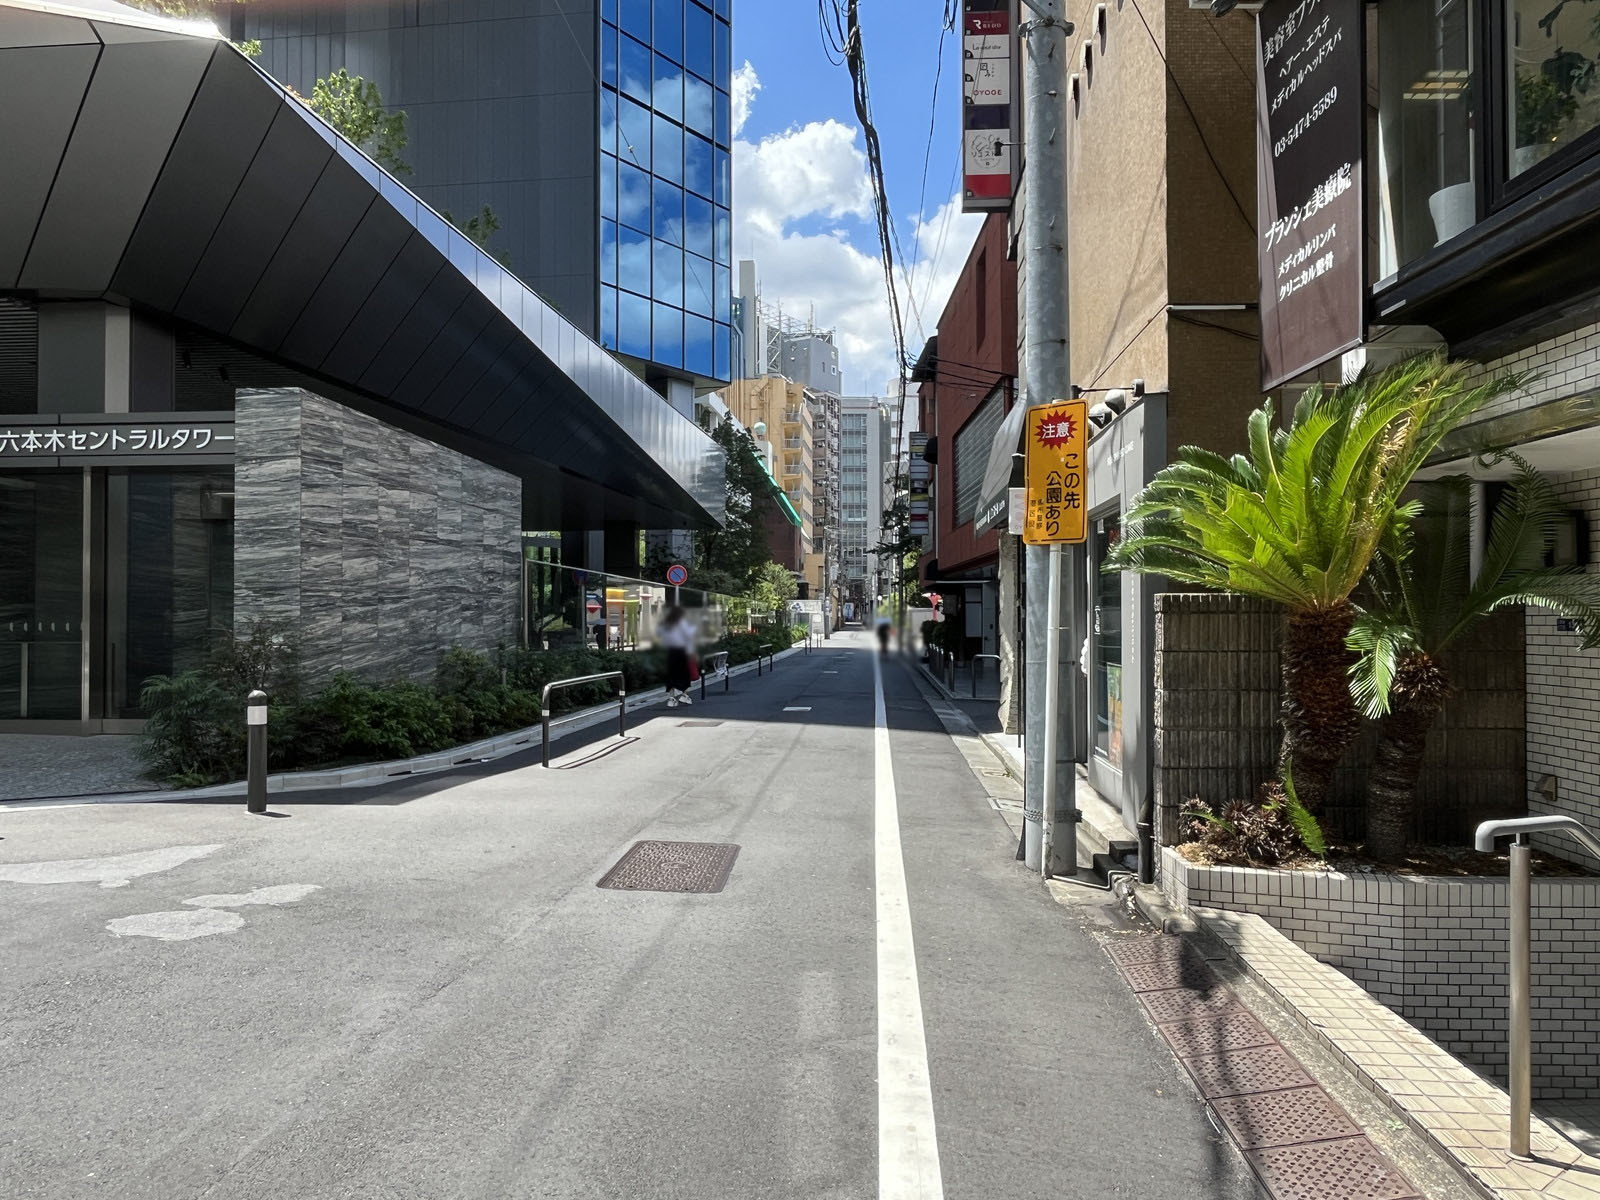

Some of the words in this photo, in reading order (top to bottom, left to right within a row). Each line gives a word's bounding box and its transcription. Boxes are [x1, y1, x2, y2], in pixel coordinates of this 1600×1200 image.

[1274, 86, 1338, 158] 03-5474-5589
[0, 428, 235, 452] 六本木セントラルタワー
[1041, 422, 1070, 439] 注意
[1045, 470, 1063, 537] 公園あり
[1063, 452, 1081, 510] この先
